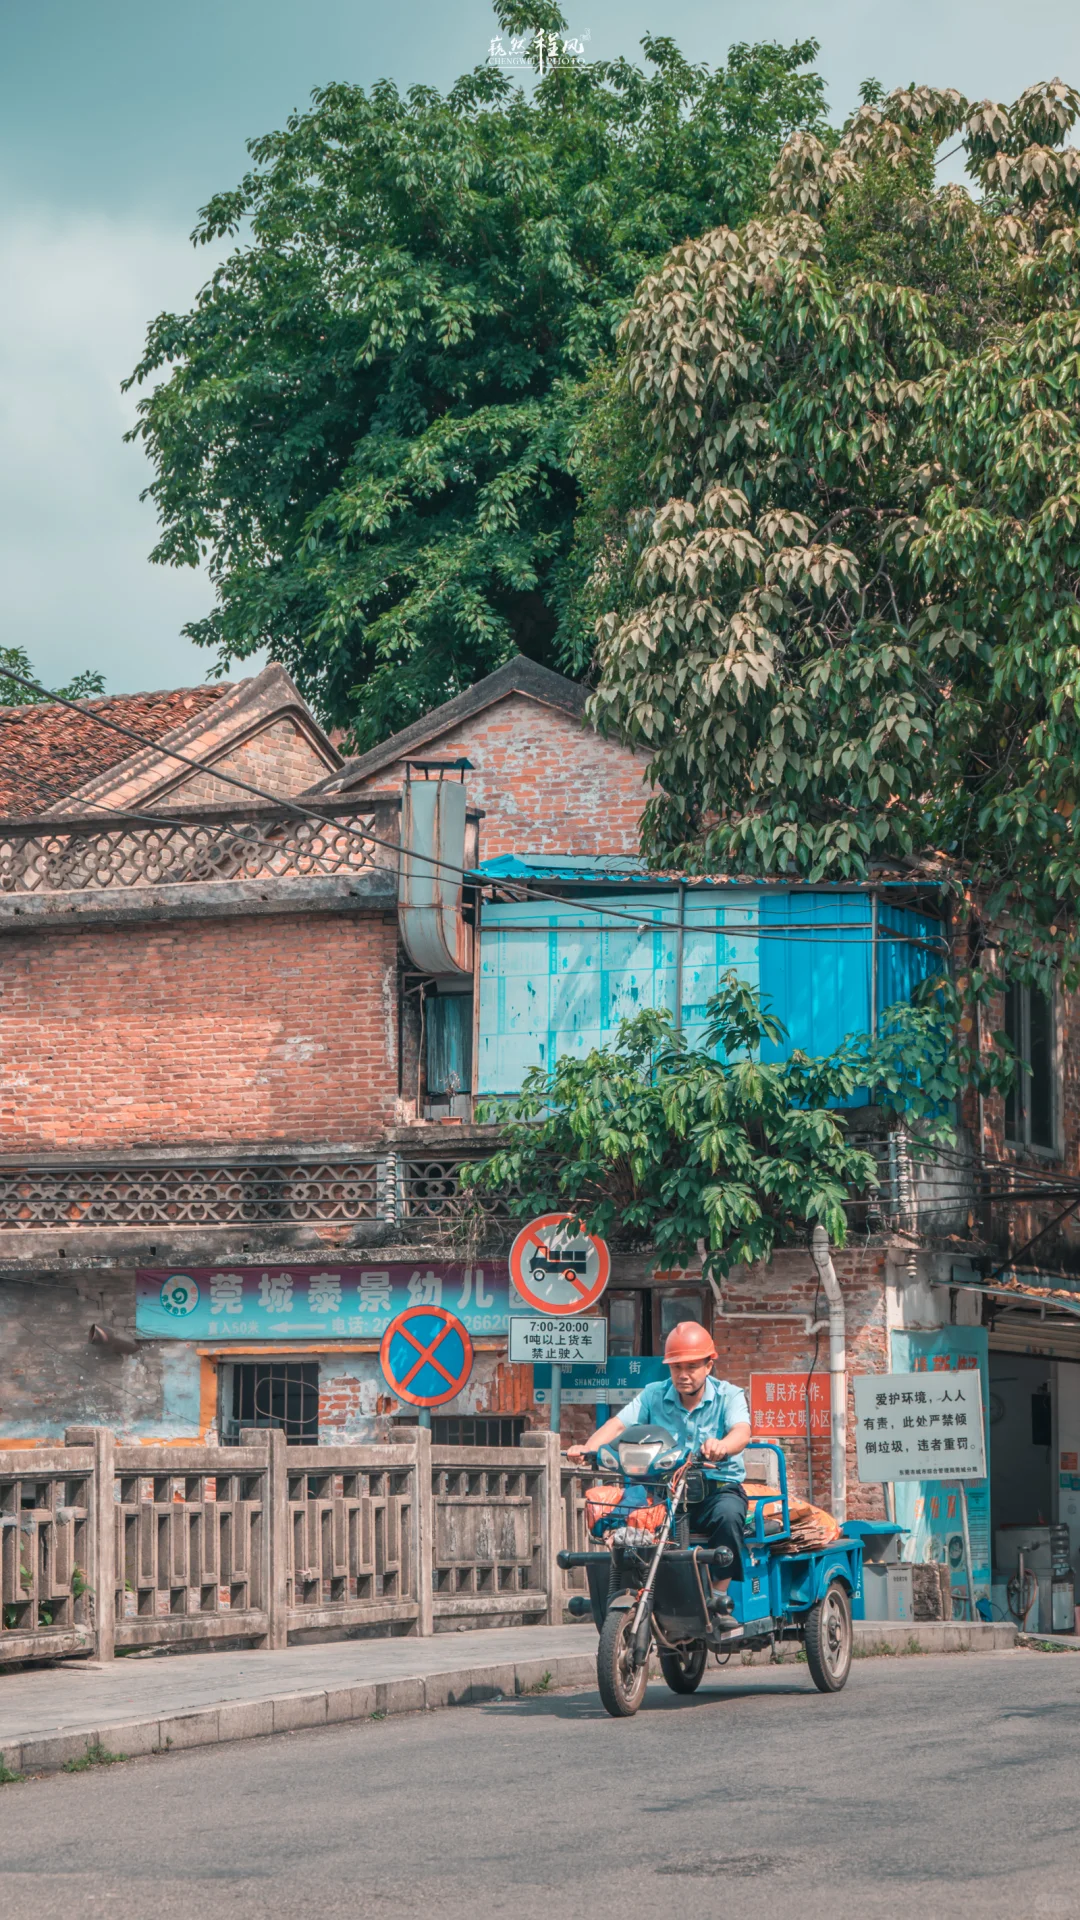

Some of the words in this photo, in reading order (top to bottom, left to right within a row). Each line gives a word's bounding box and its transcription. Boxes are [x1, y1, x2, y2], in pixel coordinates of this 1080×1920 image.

[463, 1314, 516, 1331] 26620
[530, 1321, 589, 1332] 7:00-20:00
[523, 1334, 593, 1346] 1吨以上货车
[532, 1348, 584, 1359] 禁止驶入
[574, 1378, 610, 1387] SHANZHOU
[616, 1378, 627, 1387] JIE
[753, 1409, 831, 1428] 建安全文明小区
